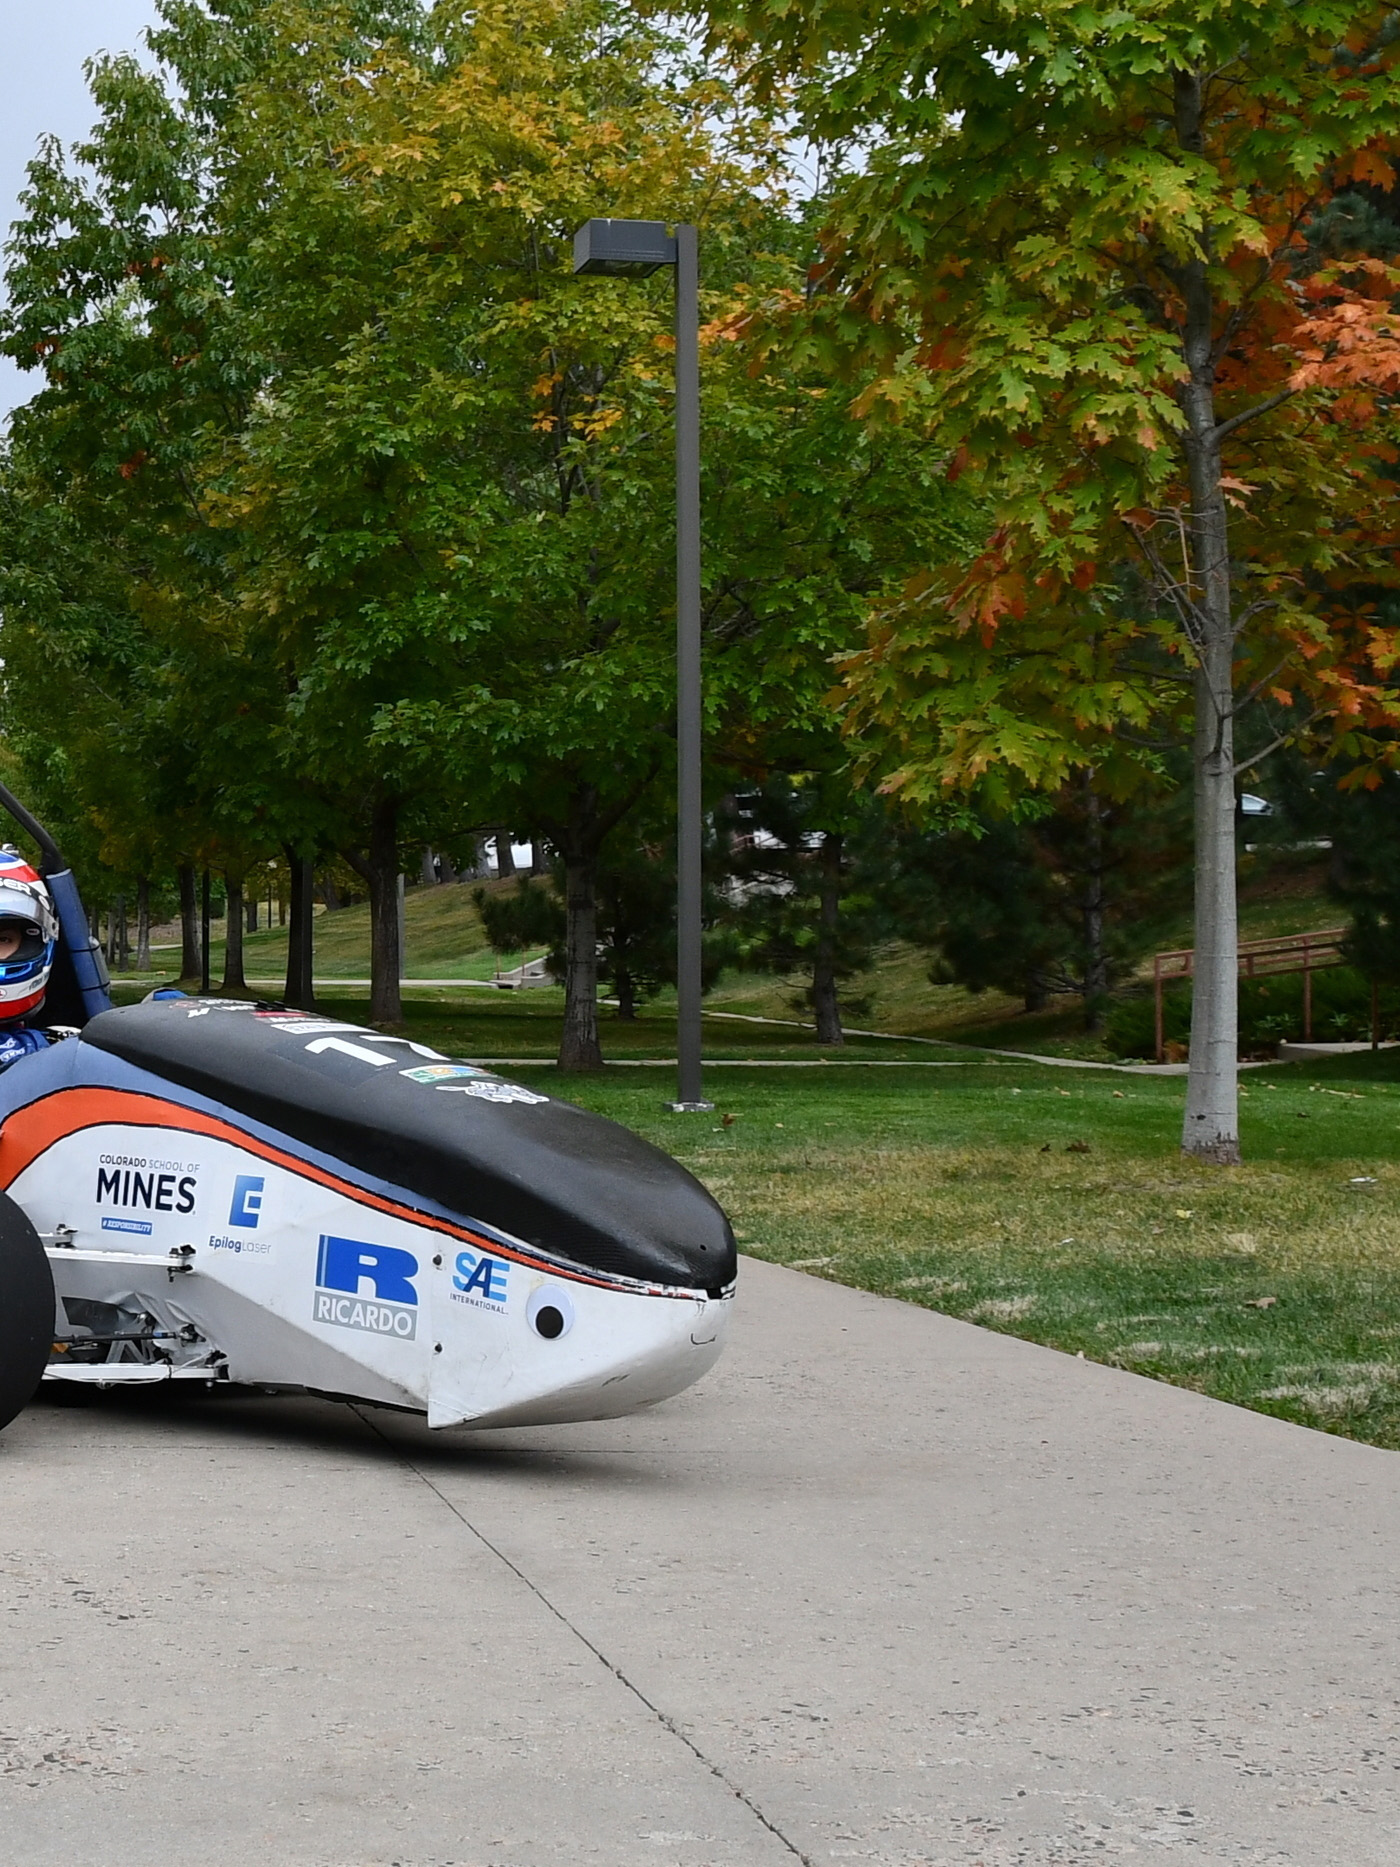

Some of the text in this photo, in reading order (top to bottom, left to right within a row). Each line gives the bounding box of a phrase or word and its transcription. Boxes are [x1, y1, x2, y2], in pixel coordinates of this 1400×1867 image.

[100, 1154, 200, 1173] COLORADO SCHOOL OF
[96, 1167, 197, 1214] MINES
[315, 1234, 419, 1306] R
[453, 1251, 510, 1302] SAE
[317, 1296, 413, 1336] RICARDO
